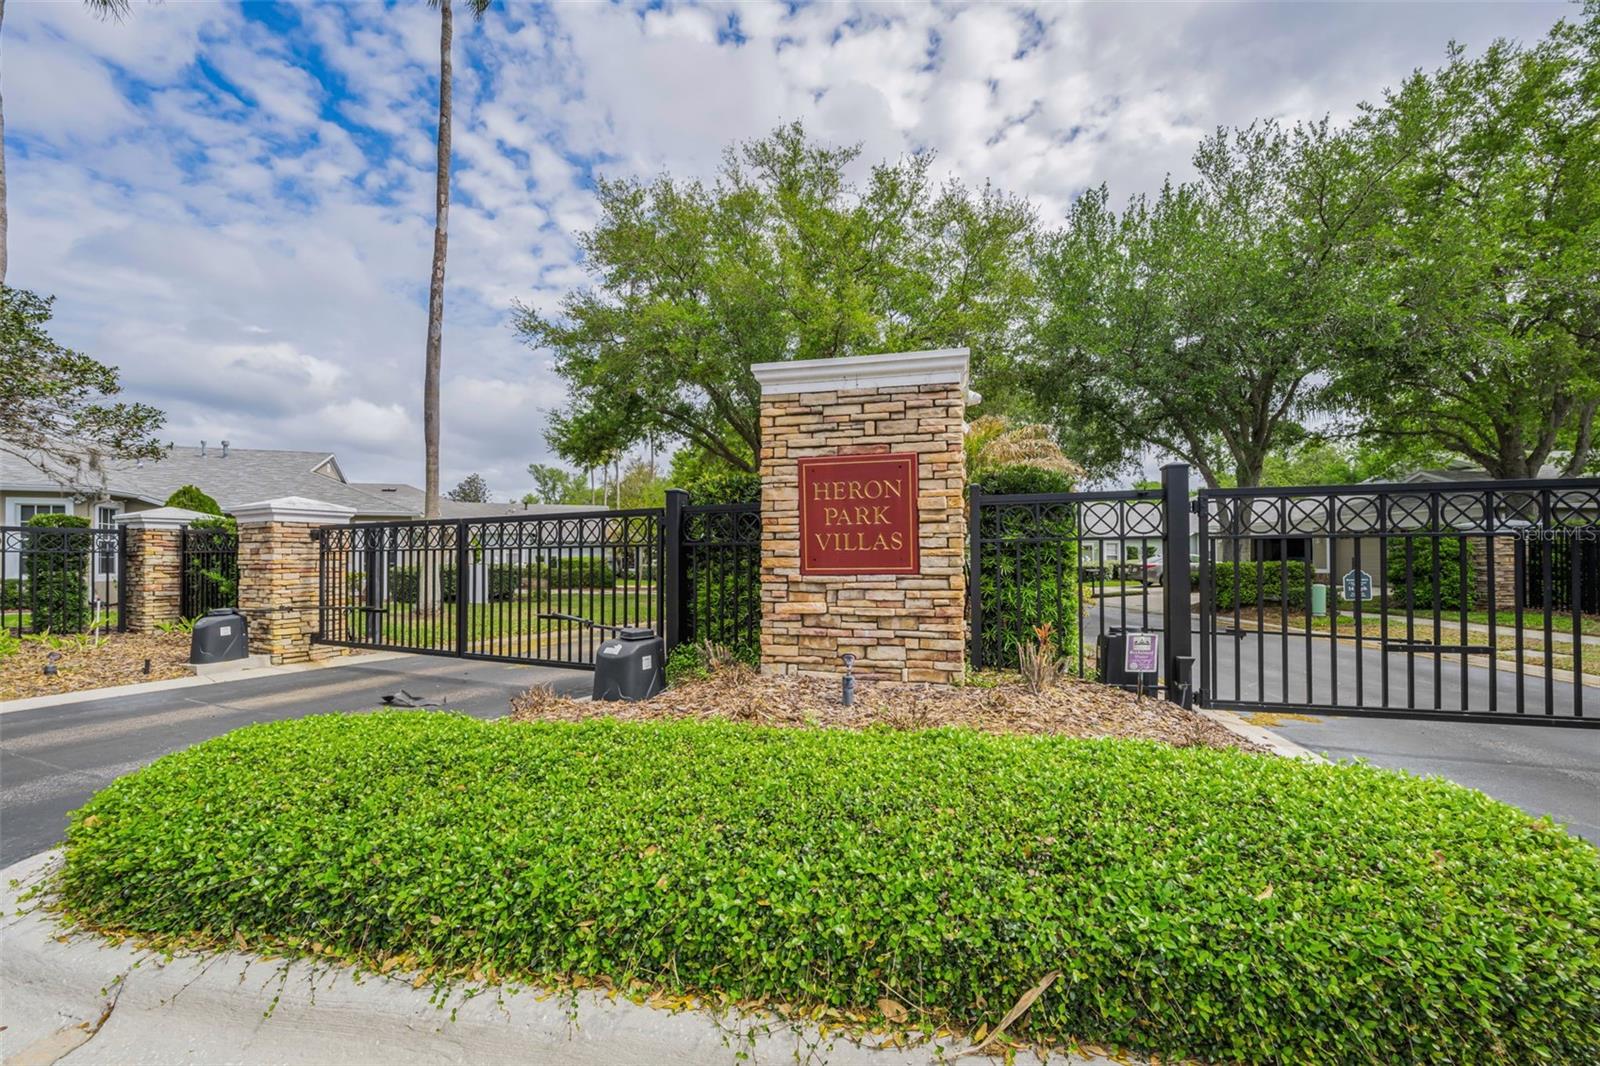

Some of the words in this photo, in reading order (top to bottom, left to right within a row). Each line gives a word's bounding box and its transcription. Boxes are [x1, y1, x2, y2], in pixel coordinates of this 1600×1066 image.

[812, 479, 903, 501] HERON
[823, 505, 892, 526] PARK
[815, 531, 903, 551] VILLAS
